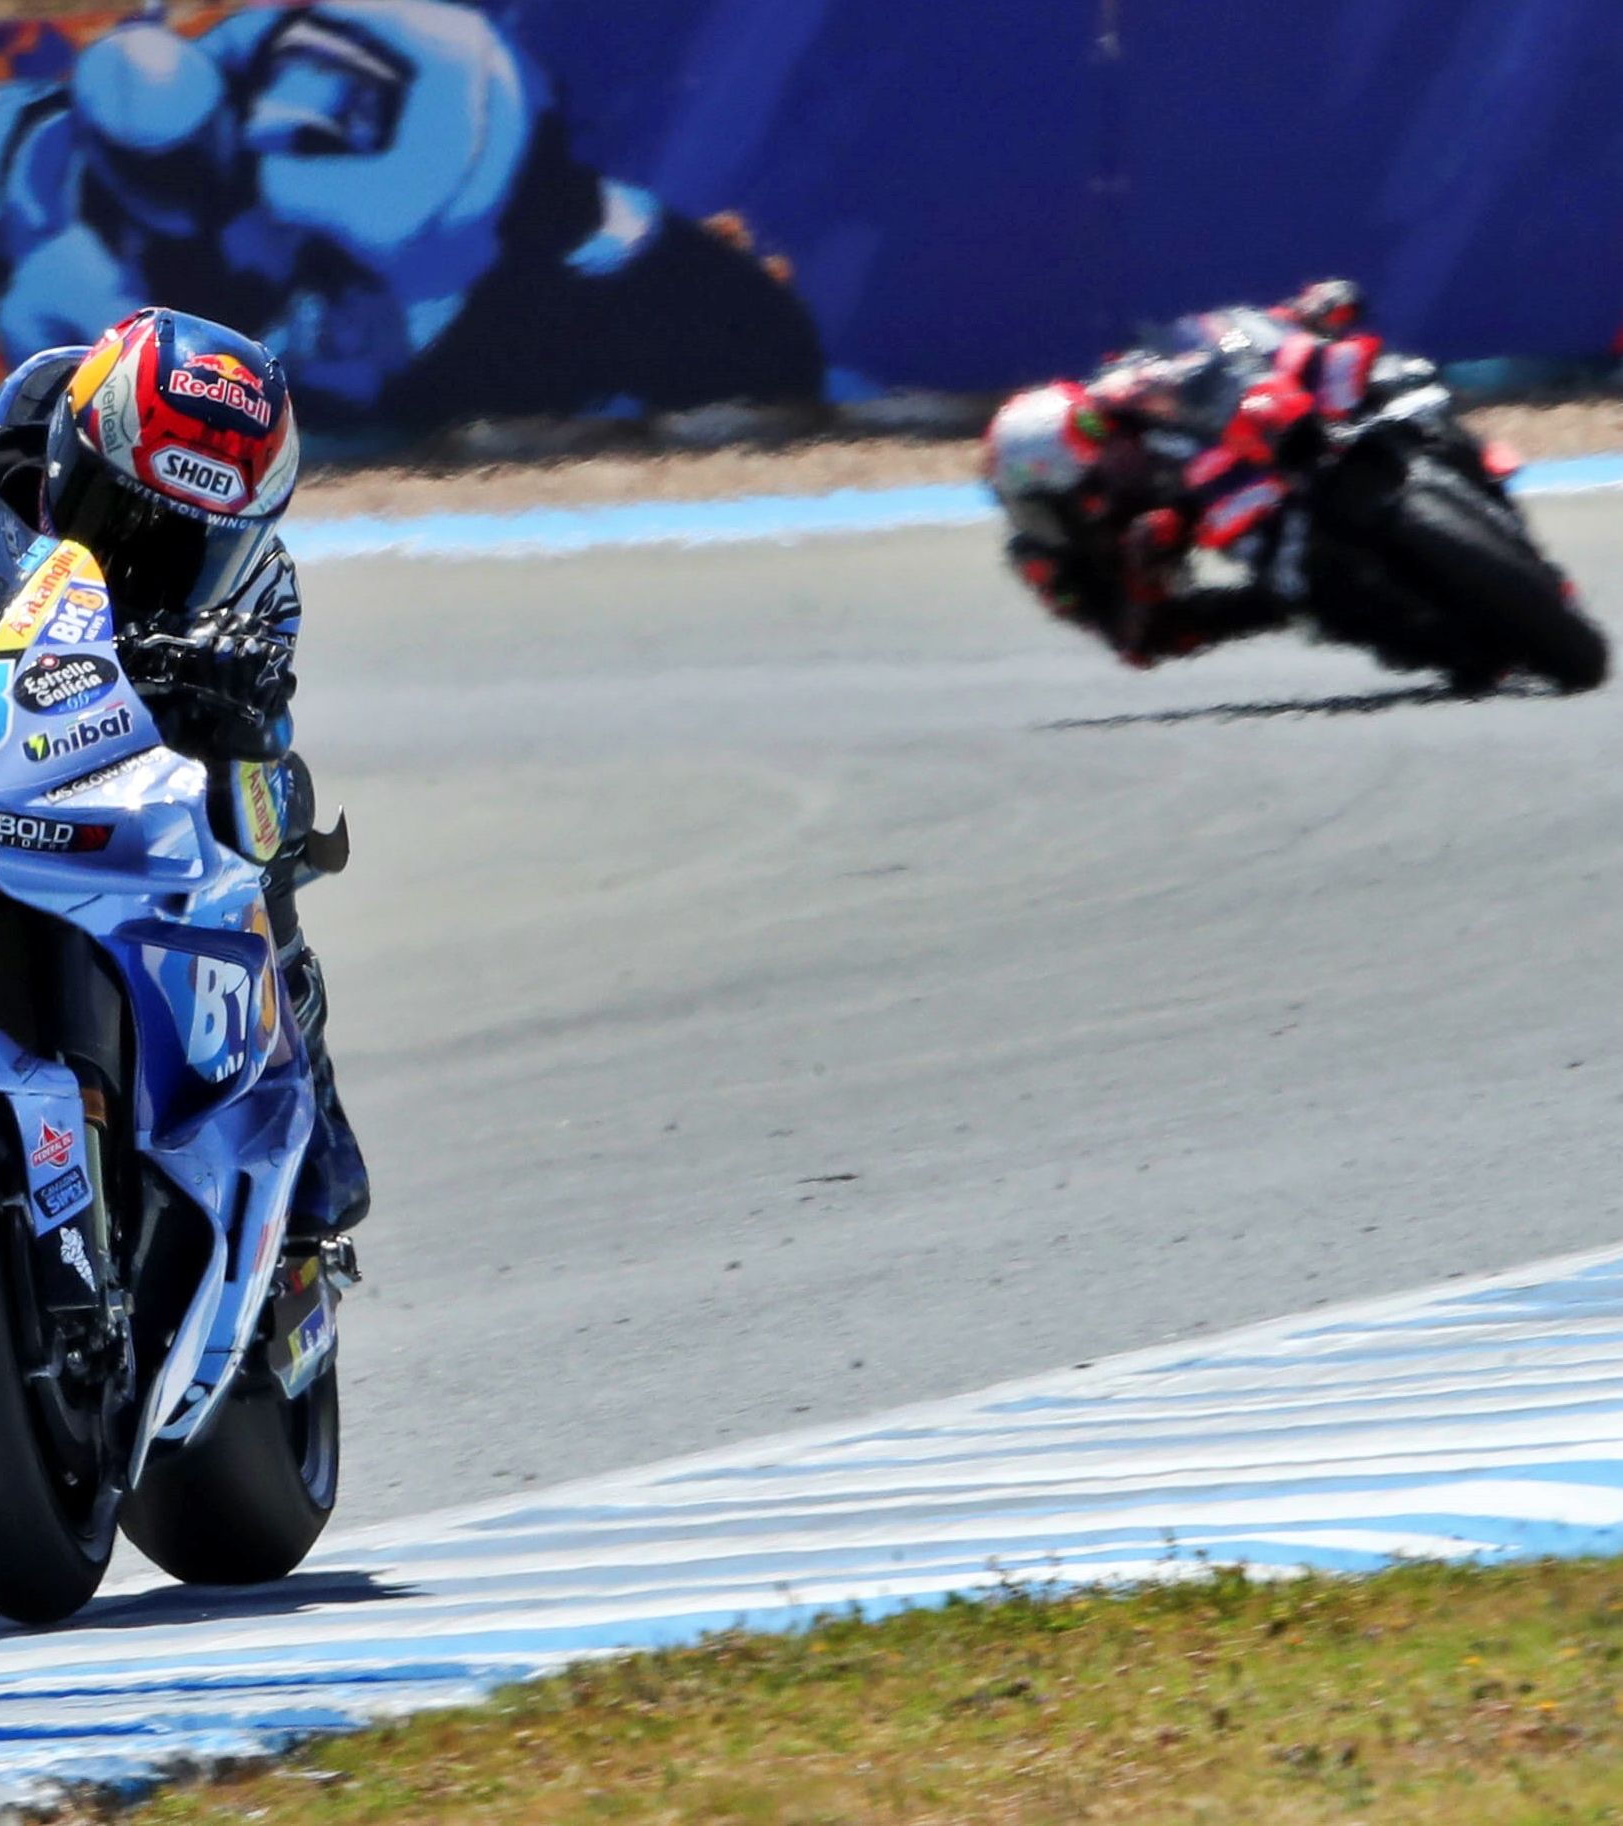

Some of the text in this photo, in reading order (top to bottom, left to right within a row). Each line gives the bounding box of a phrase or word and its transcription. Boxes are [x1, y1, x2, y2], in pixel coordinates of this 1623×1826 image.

[169, 369, 272, 429] Red Bull
[162, 454, 234, 497] SHOEI
[169, 499, 201, 519] YOU
[47, 588, 109, 645] BK8
[23, 659, 97, 695] Estrella
[35, 672, 103, 707] Galicia
[22, 705, 134, 764] Unibat
